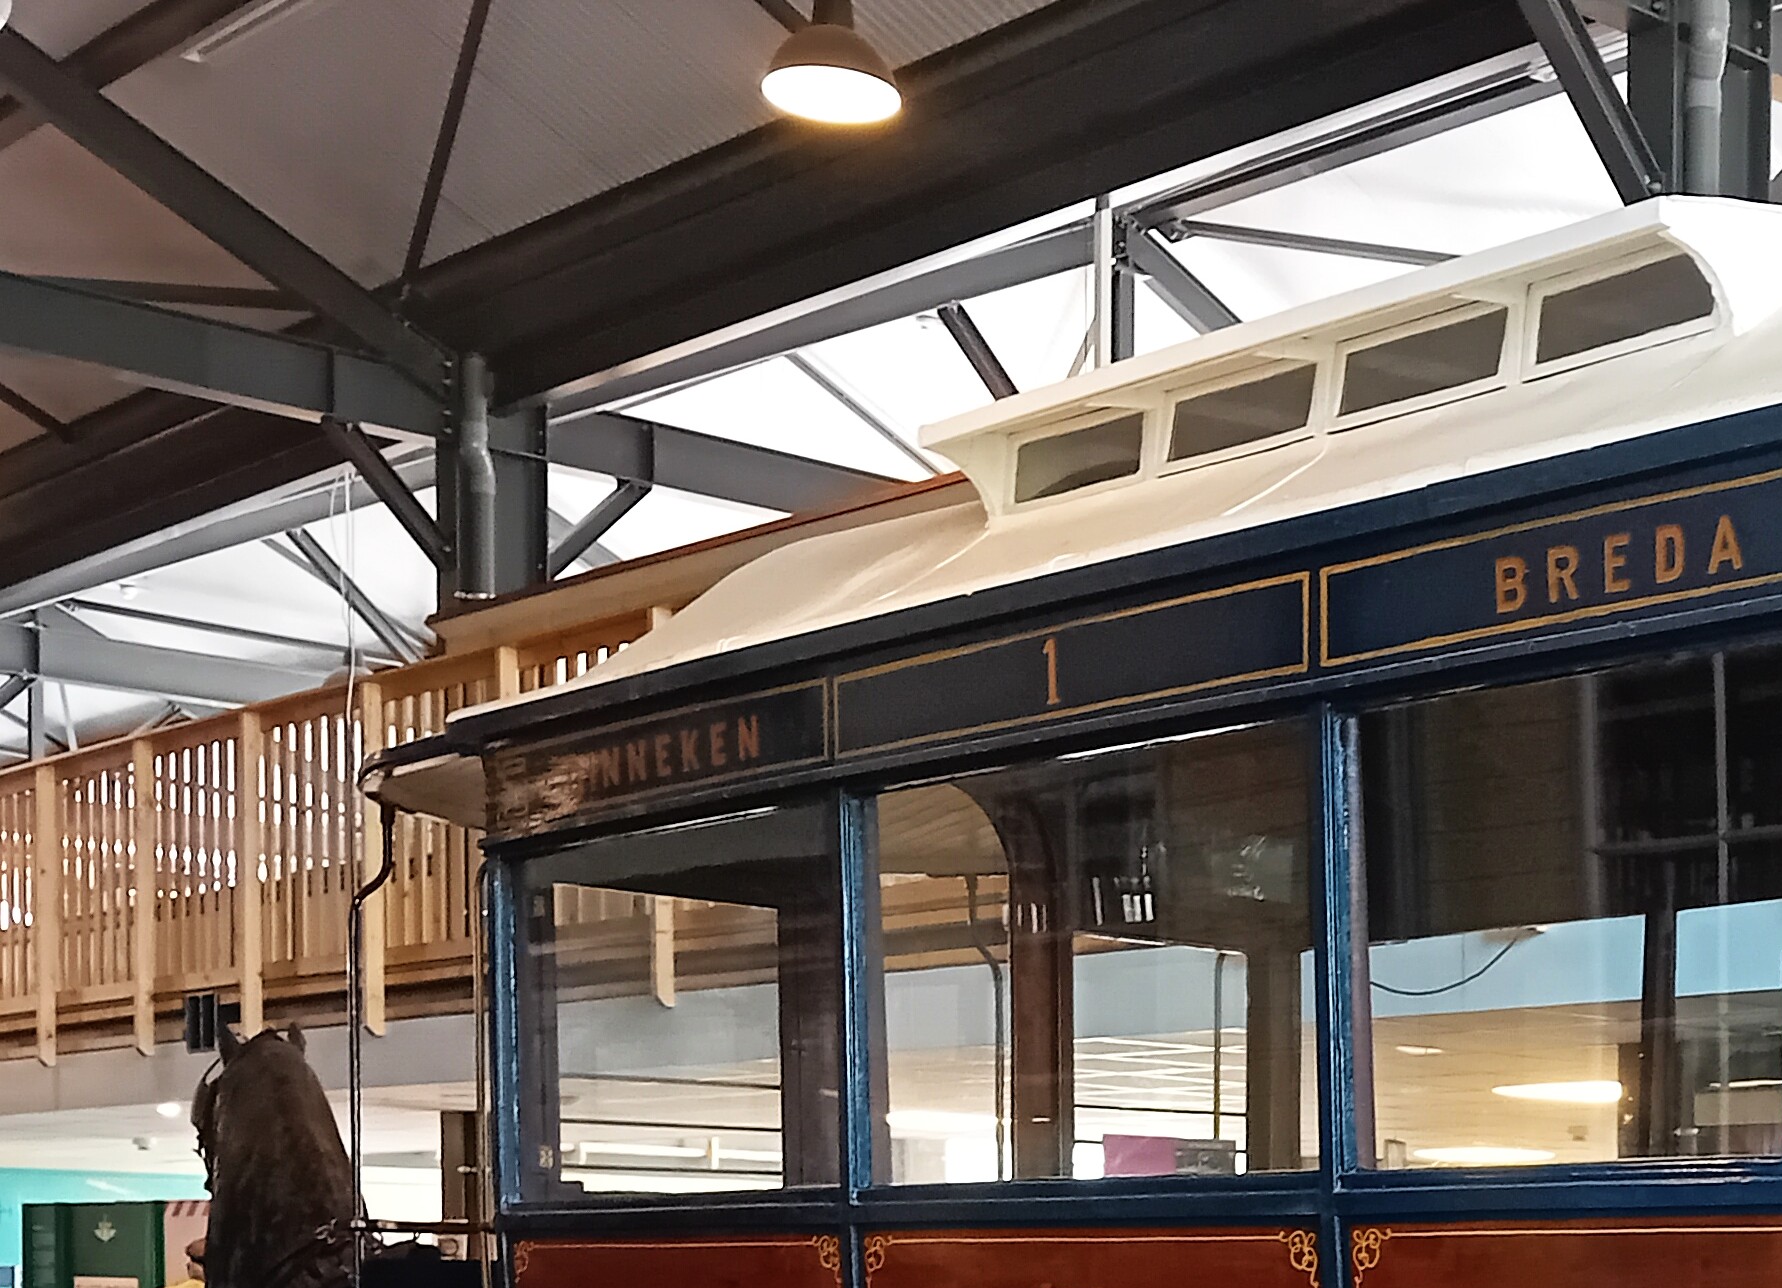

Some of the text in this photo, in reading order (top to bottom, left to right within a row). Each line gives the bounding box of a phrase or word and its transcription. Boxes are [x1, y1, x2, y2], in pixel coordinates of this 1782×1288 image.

[1495, 515, 1743, 613] BREDA
[1042, 637, 1061, 705] 1
[570, 715, 761, 797] INNEKEN
